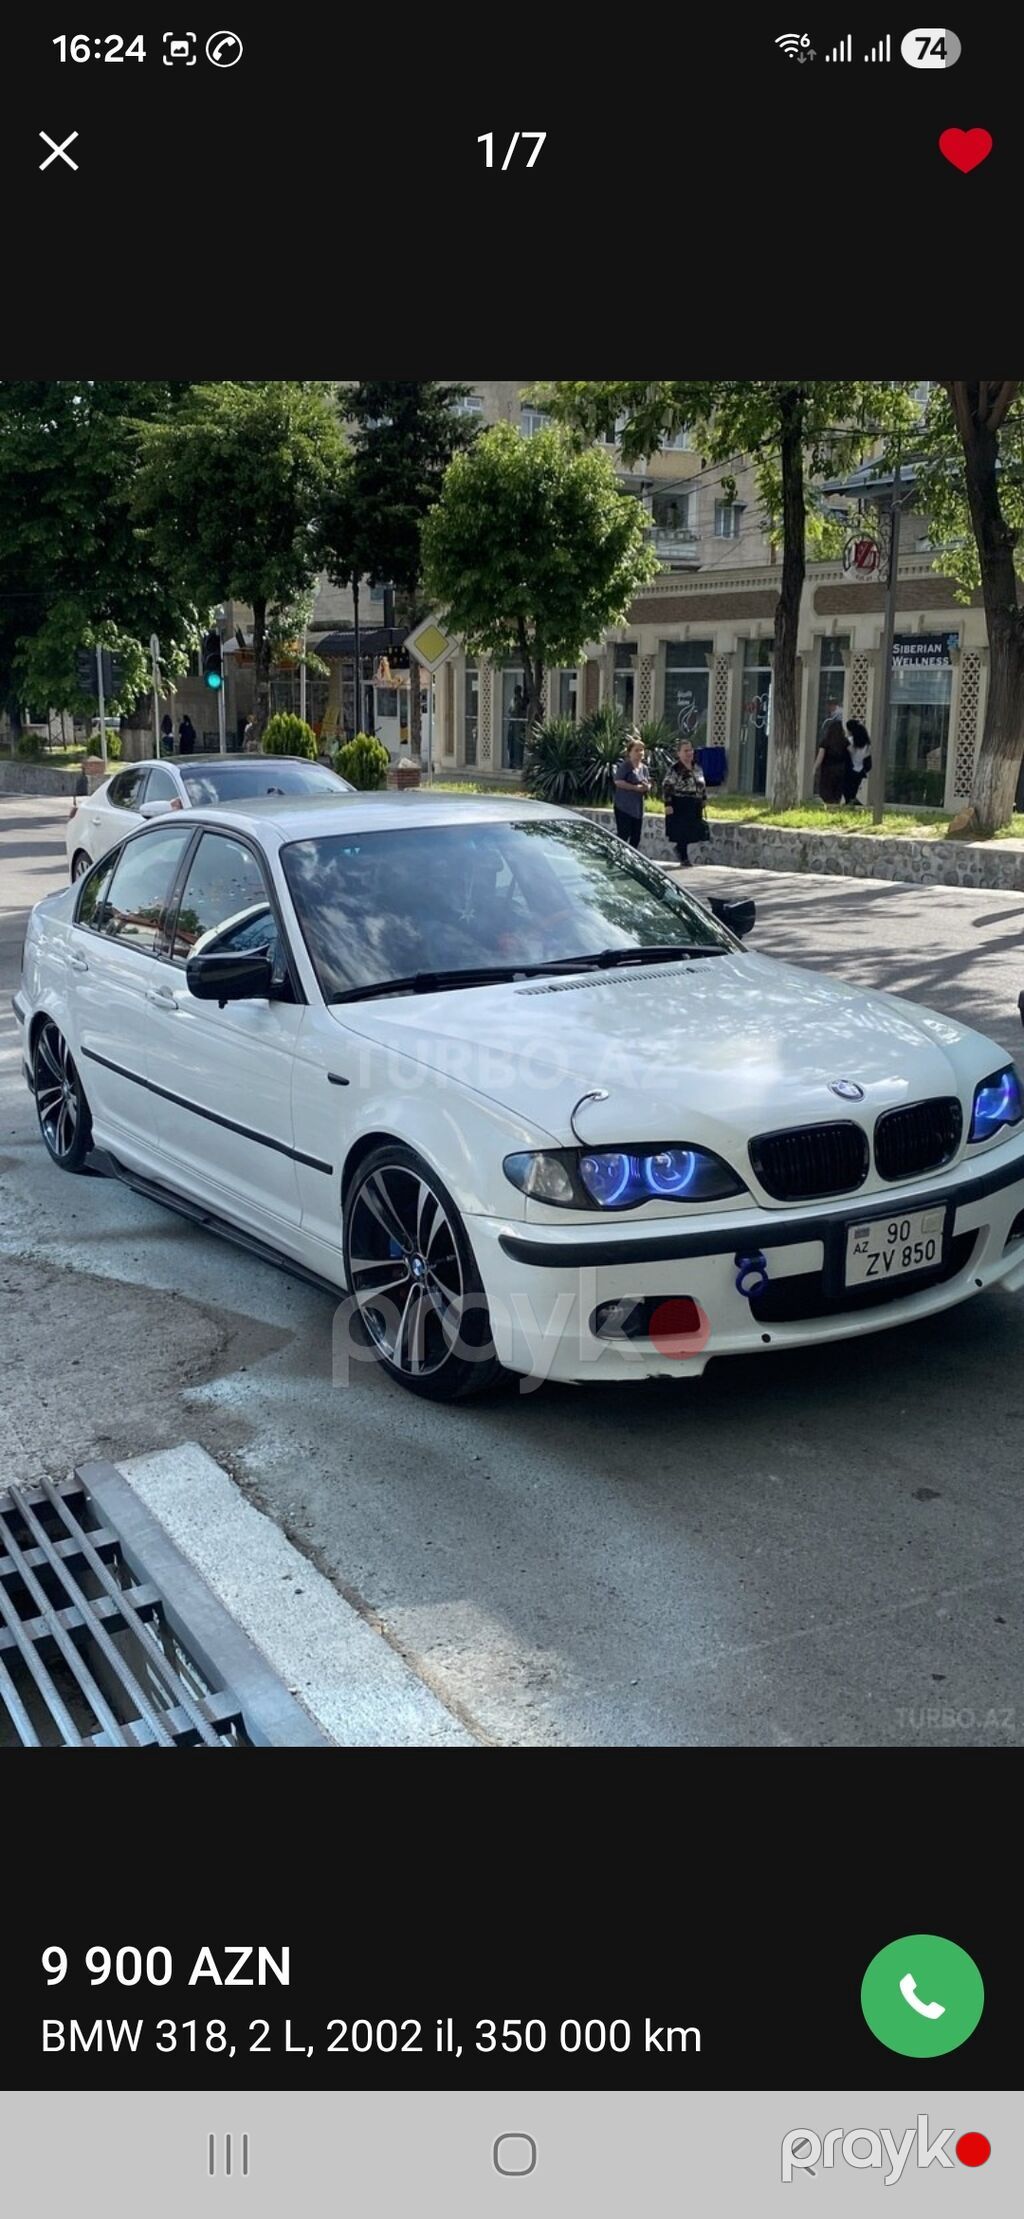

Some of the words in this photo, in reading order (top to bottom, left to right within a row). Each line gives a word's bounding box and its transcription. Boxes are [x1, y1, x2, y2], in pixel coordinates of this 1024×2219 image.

[52, 34, 147, 63] 16:24
[799, 32, 811, 48] 6
[914, 36, 948, 61] 74
[477, 131, 547, 171] 1/7
[892, 643, 943, 654] SIBERIAN
[892, 656, 950, 666] WELLNESS
[887, 1220, 911, 1244] 90
[853, 1241, 869, 1255] AZ
[866, 1249, 895, 1276] ZV
[901, 1239, 936, 1267] 850
[41, 1945, 68, 1986] 9
[85, 1945, 173, 1987] 900
[187, 1946, 290, 1986] AZN
[42, 2019, 144, 2052] BMW
[155, 2018, 236, 2058] 318,
[248, 2019, 272, 2052] 2
[285, 2019, 314, 2058] L,
[326, 2019, 423, 2053] 2002
[436, 2017, 463, 2058] il,
[475, 2019, 547, 2053] 350
[560, 2019, 631, 2053] 000
[645, 2017, 701, 2052] km
